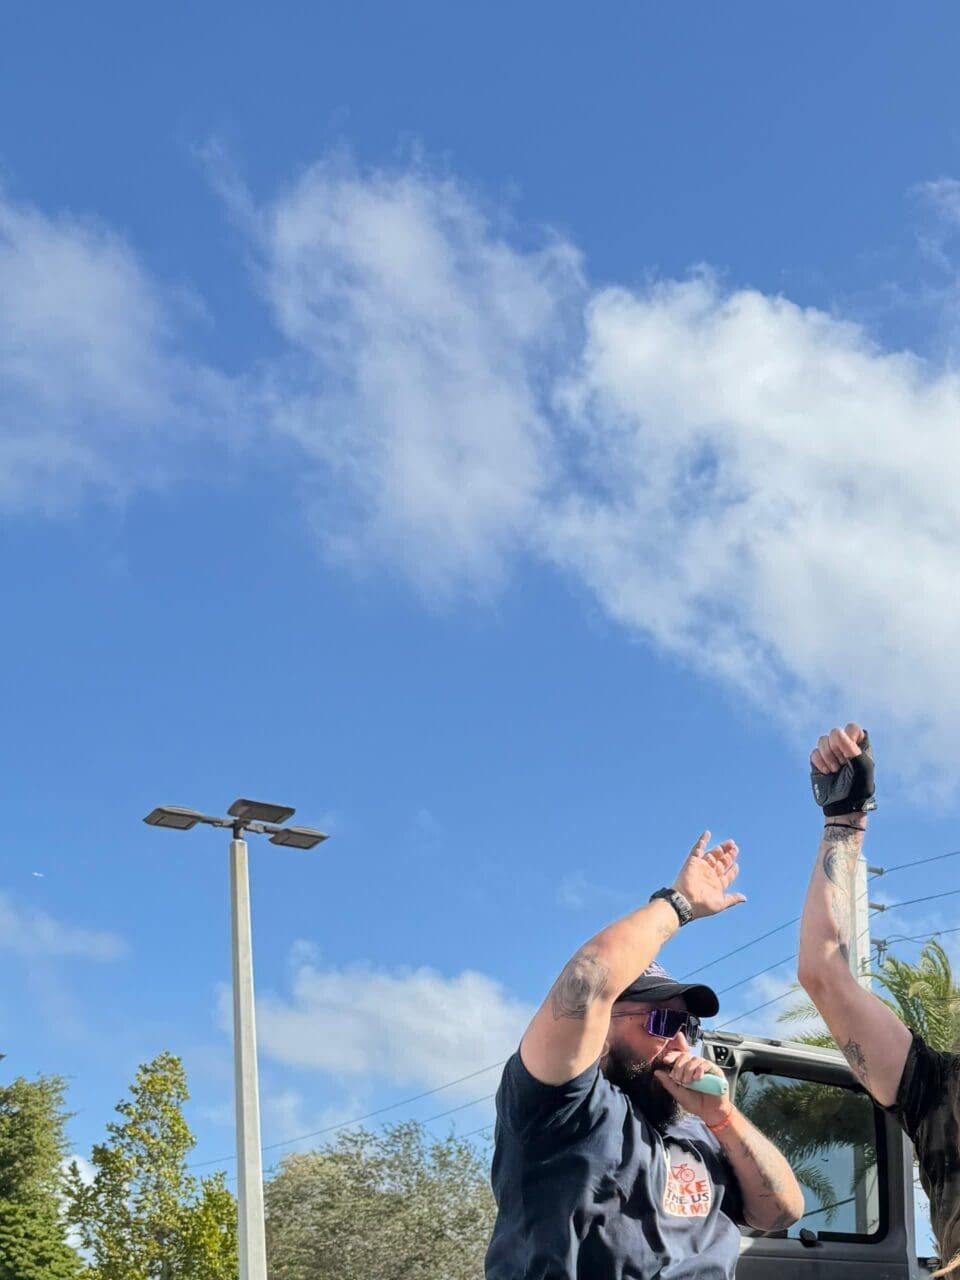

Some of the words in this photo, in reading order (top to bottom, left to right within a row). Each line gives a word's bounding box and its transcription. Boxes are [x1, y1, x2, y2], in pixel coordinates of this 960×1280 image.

[666, 1188, 689, 1205] THE
[691, 1192, 710, 1203] US
[664, 1199, 688, 1215] FOR
